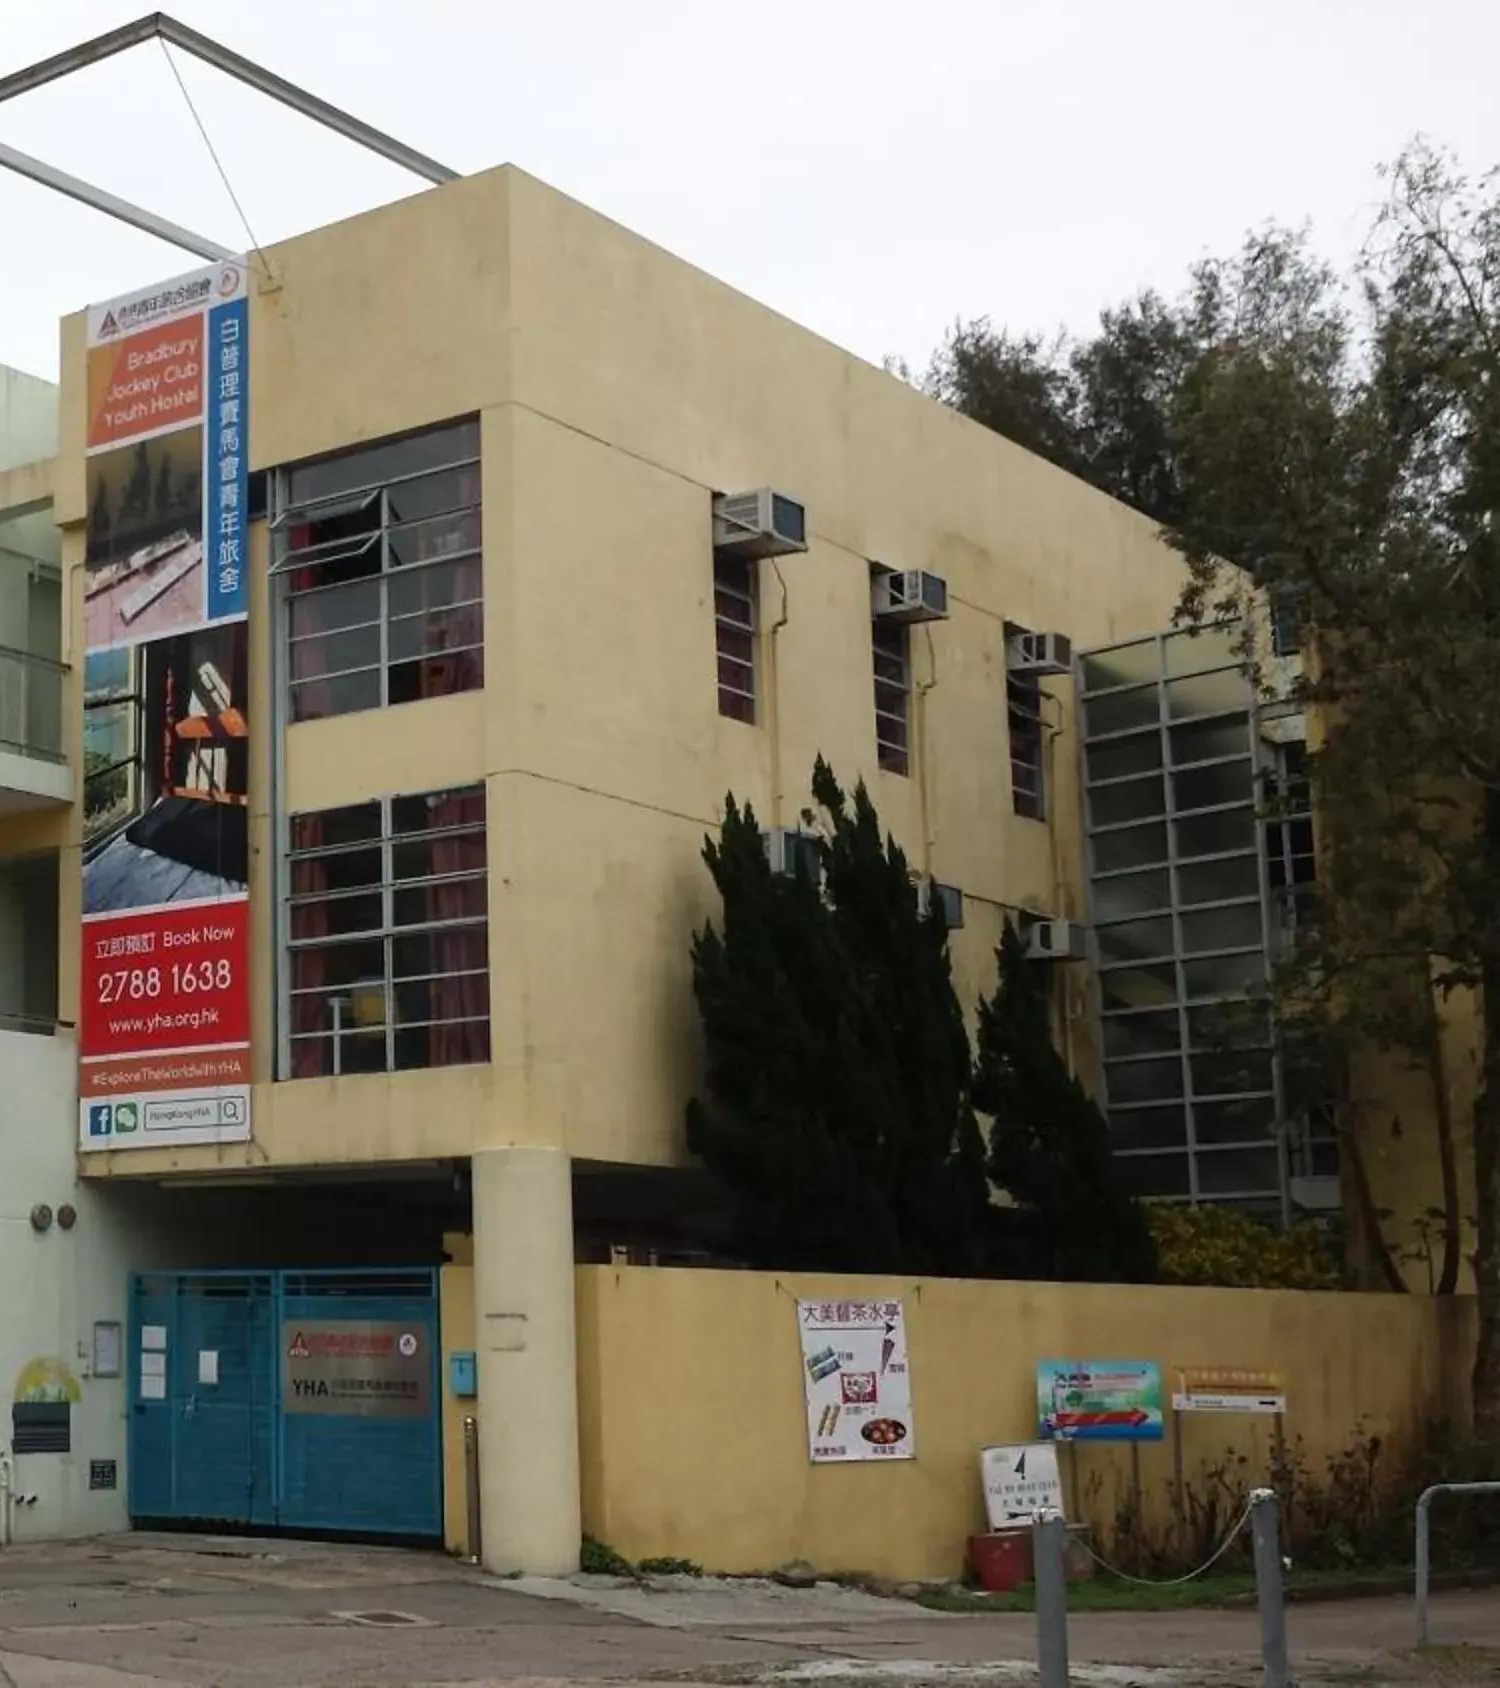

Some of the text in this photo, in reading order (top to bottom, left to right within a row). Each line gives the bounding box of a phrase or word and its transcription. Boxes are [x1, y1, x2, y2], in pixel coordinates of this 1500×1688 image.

[127, 337, 198, 371] Bradbury
[107, 361, 198, 403] Jockey Club
[105, 386, 199, 428] Youth Hostel
[163, 928, 200, 947] Book
[203, 926, 235, 943] Now
[98, 959, 232, 1004] 2788 1638
[109, 1007, 219, 1034] www.yha.org.hk
[293, 1378, 329, 1398] YHA
